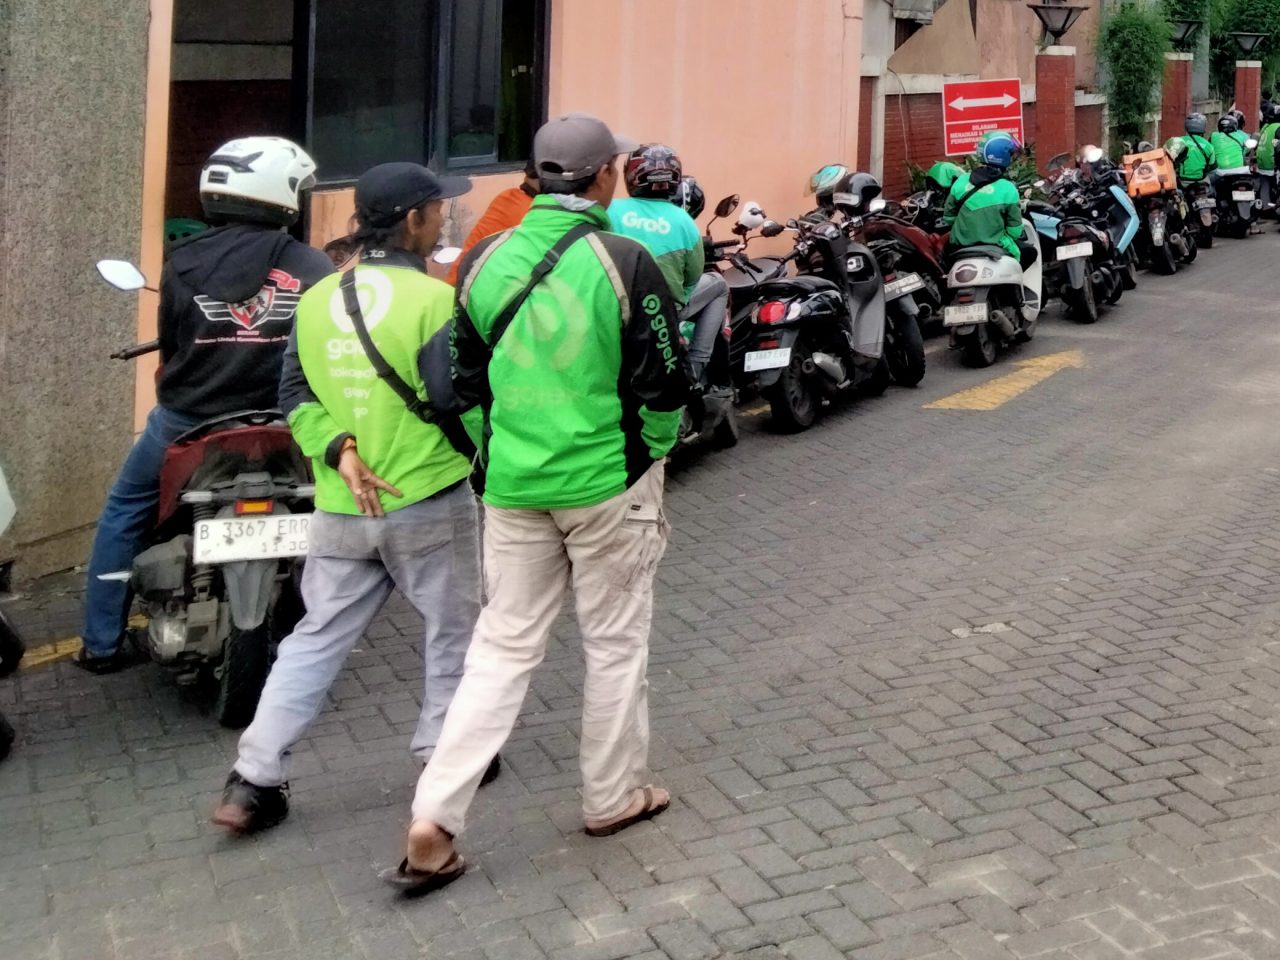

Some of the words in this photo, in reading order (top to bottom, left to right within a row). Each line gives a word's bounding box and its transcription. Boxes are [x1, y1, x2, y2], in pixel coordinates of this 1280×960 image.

[622, 211, 672, 234] Grab
[650, 314, 677, 375] gojek
[200, 524, 210, 540] B
[223, 520, 266, 539] 3367
